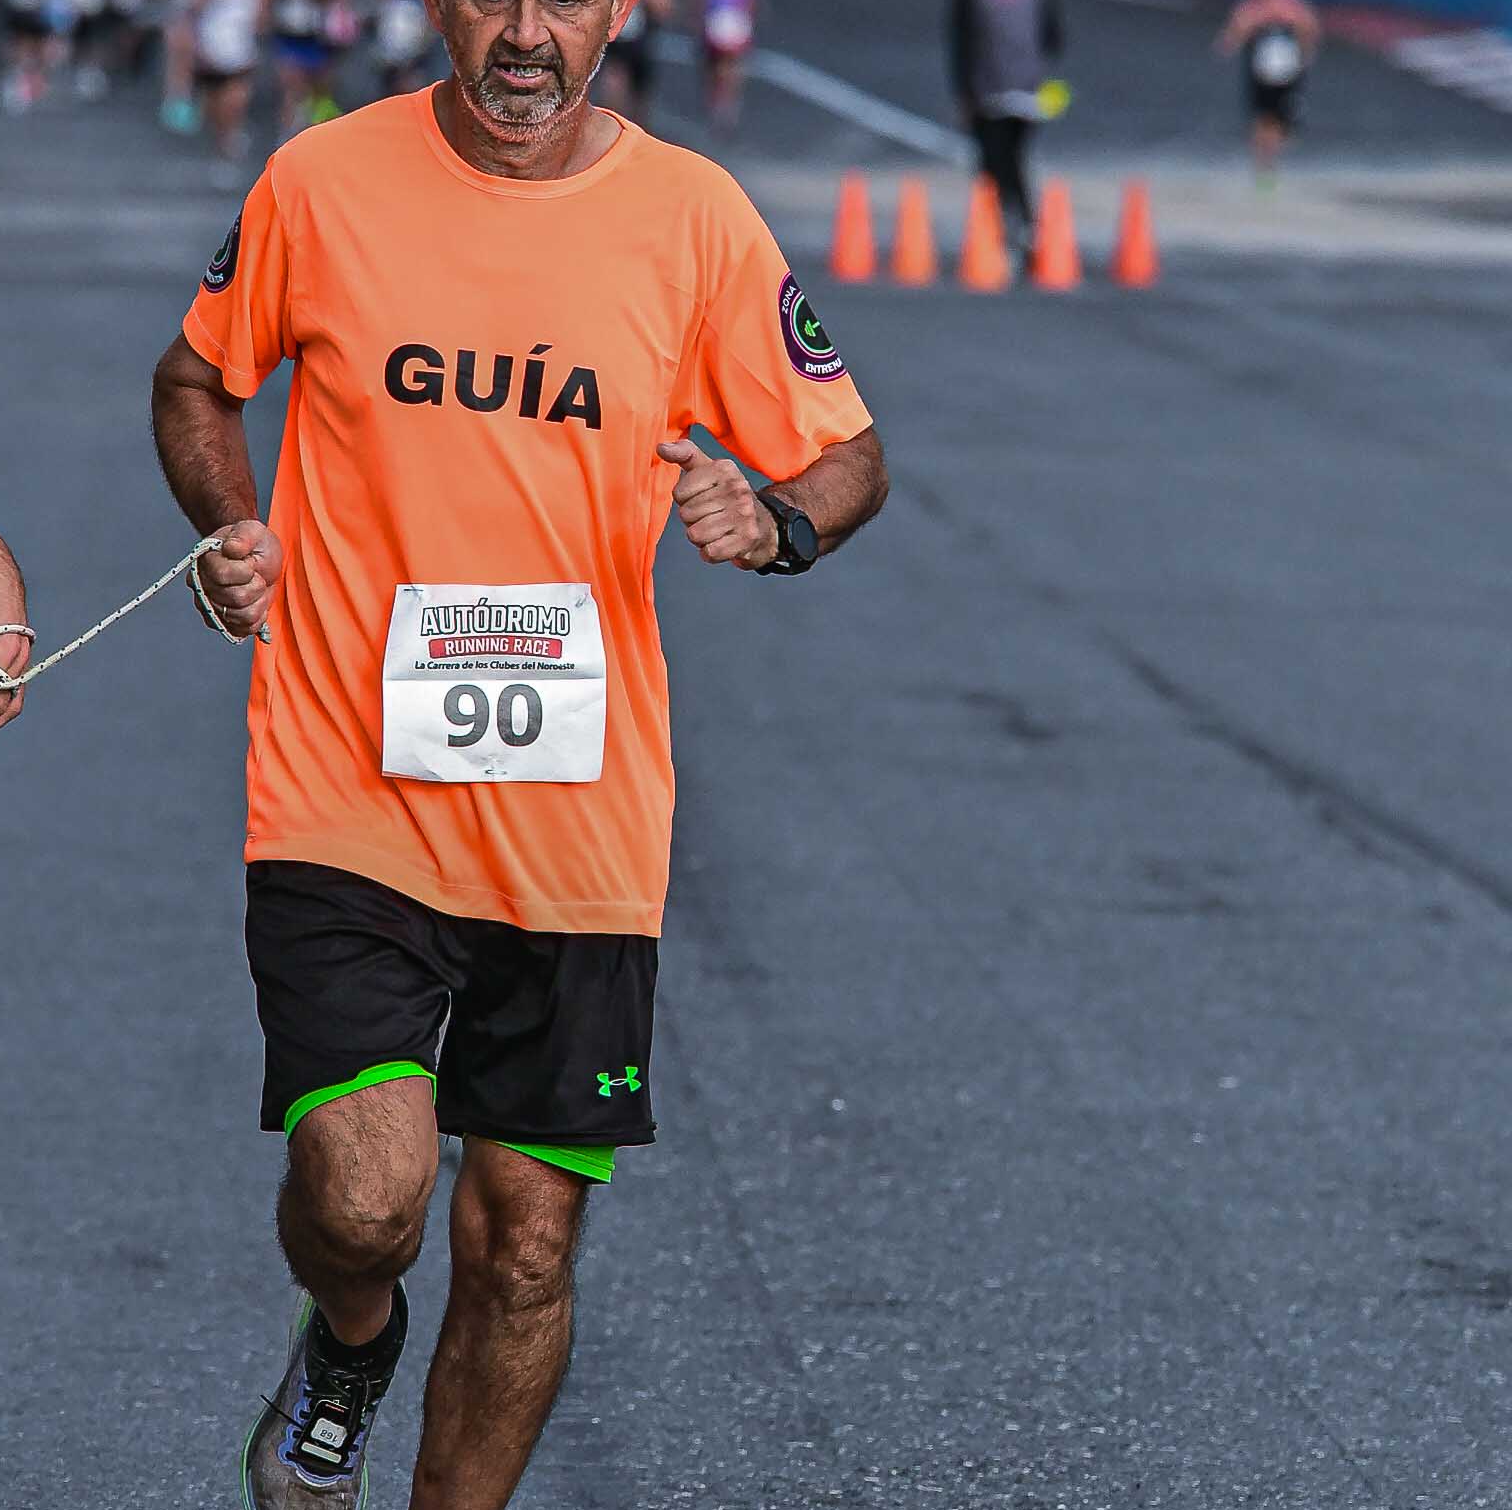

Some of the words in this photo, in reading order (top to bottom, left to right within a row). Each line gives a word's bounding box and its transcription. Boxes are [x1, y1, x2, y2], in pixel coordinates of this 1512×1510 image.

[781, 285, 796, 314] ZONA
[384, 343, 601, 430] GUÍA
[421, 597, 570, 637] AUTÓDROMO
[444, 638, 509, 655] RUNNING
[513, 638, 550, 656] RACE
[415, 661, 426, 670] La
[427, 661, 460, 670] Carrera
[462, 661, 474, 670] de
[475, 661, 489, 670] los
[490, 661, 520, 670] Clubes
[522, 661, 536, 670] del
[537, 662, 575, 670] Noroeste
[443, 683, 543, 748] 90
